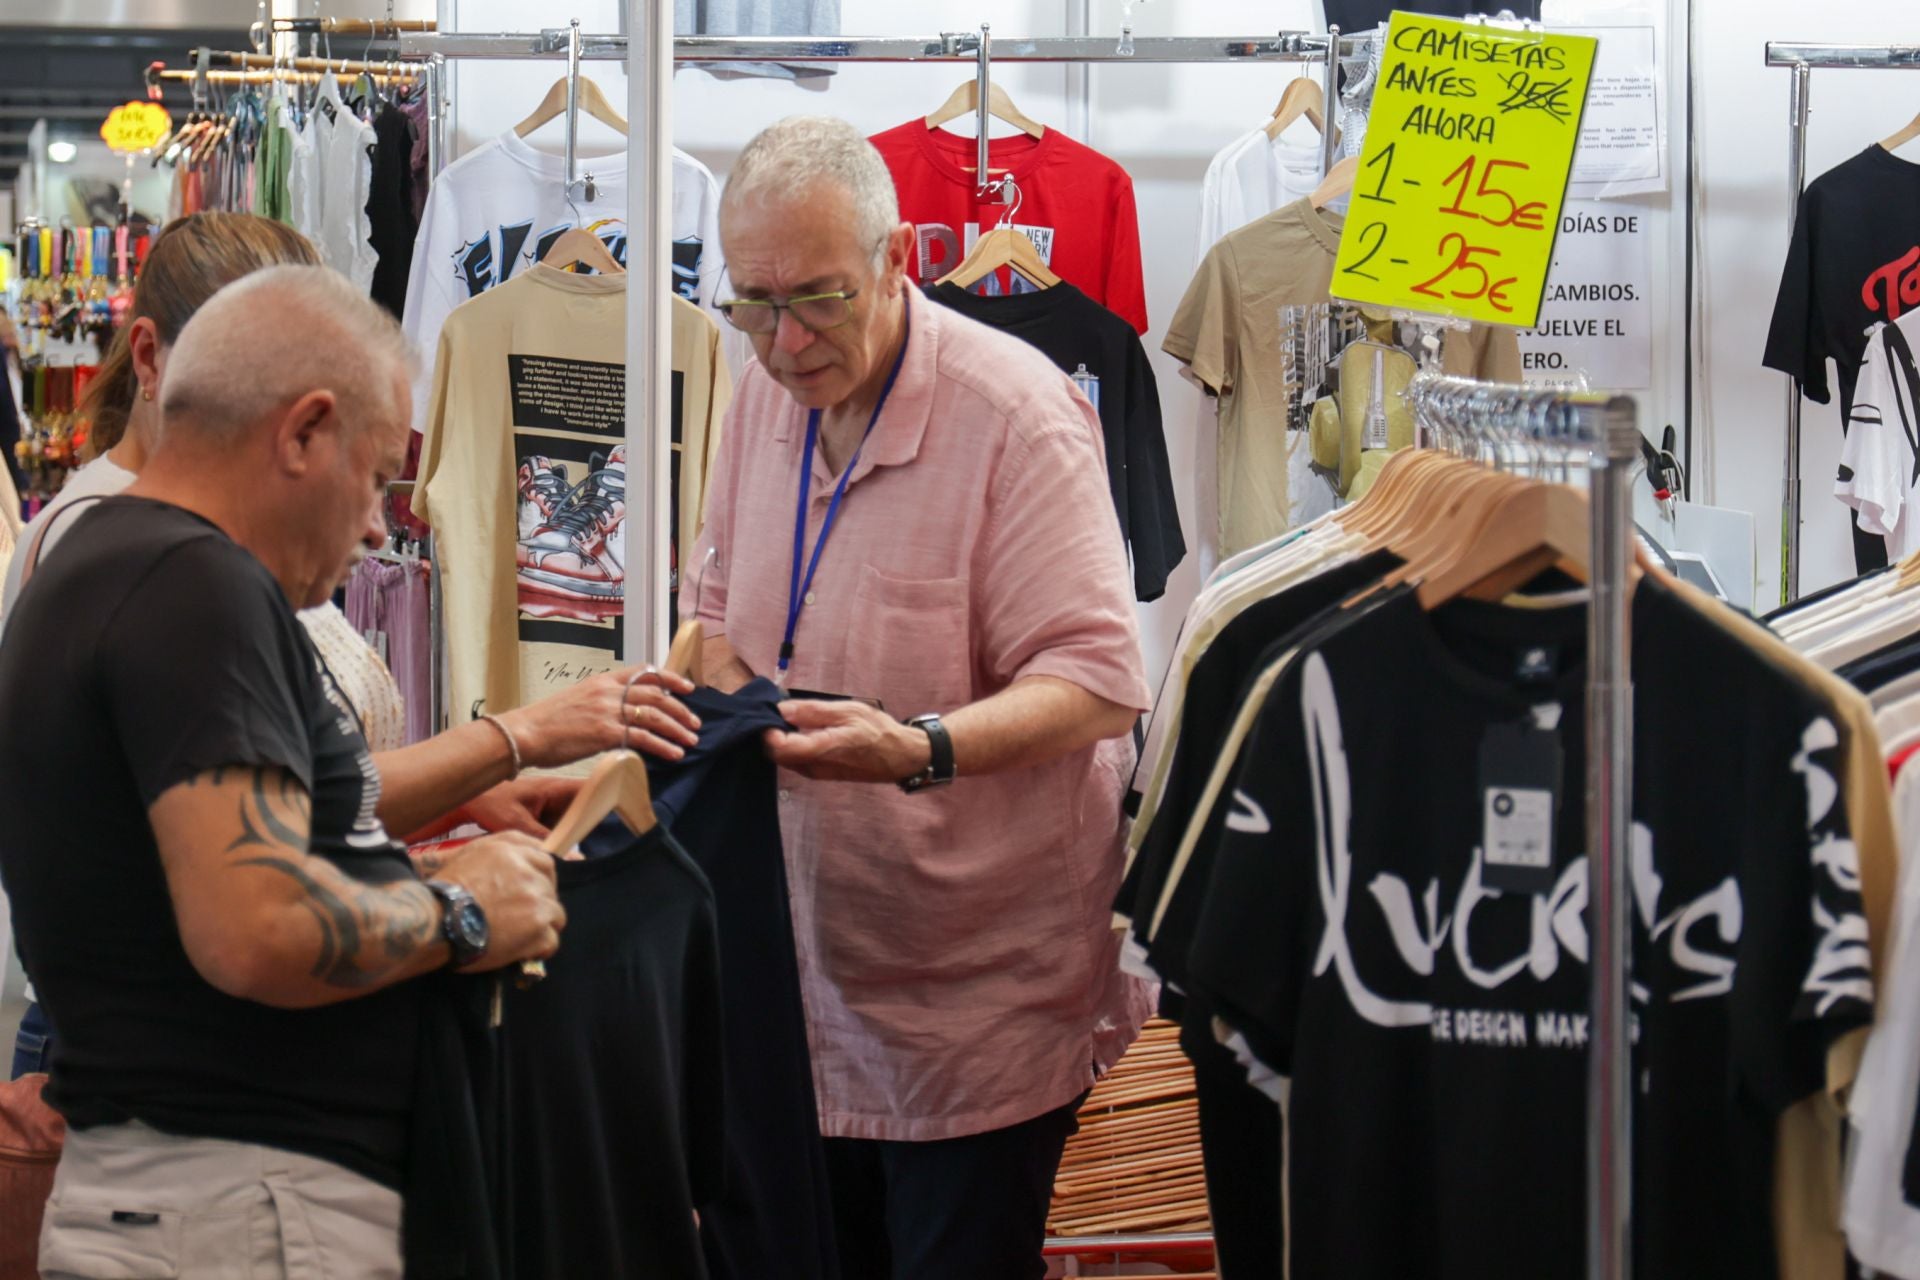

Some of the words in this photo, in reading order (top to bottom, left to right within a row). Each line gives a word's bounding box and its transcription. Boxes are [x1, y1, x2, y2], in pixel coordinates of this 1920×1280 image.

[1393, 26, 1565, 70] CAMISETAS
[1386, 62, 1477, 97] ANTES
[1401, 104, 1495, 144] AHORA
[1439, 154, 1548, 230] 15€
[1562, 212, 1607, 233] DÍAS
[1614, 217, 1638, 233] DE
[1026, 228, 1050, 243] NEW
[1410, 232, 1518, 312] 25€
[1516, 319, 1597, 336] UELVE
[1604, 319, 1625, 336] EL
[535, 368, 555, 376] further
[581, 363, 609, 374] constantly
[537, 383, 560, 391] fashion
[603, 389, 619, 398] break
[544, 392, 585, 403] championship
